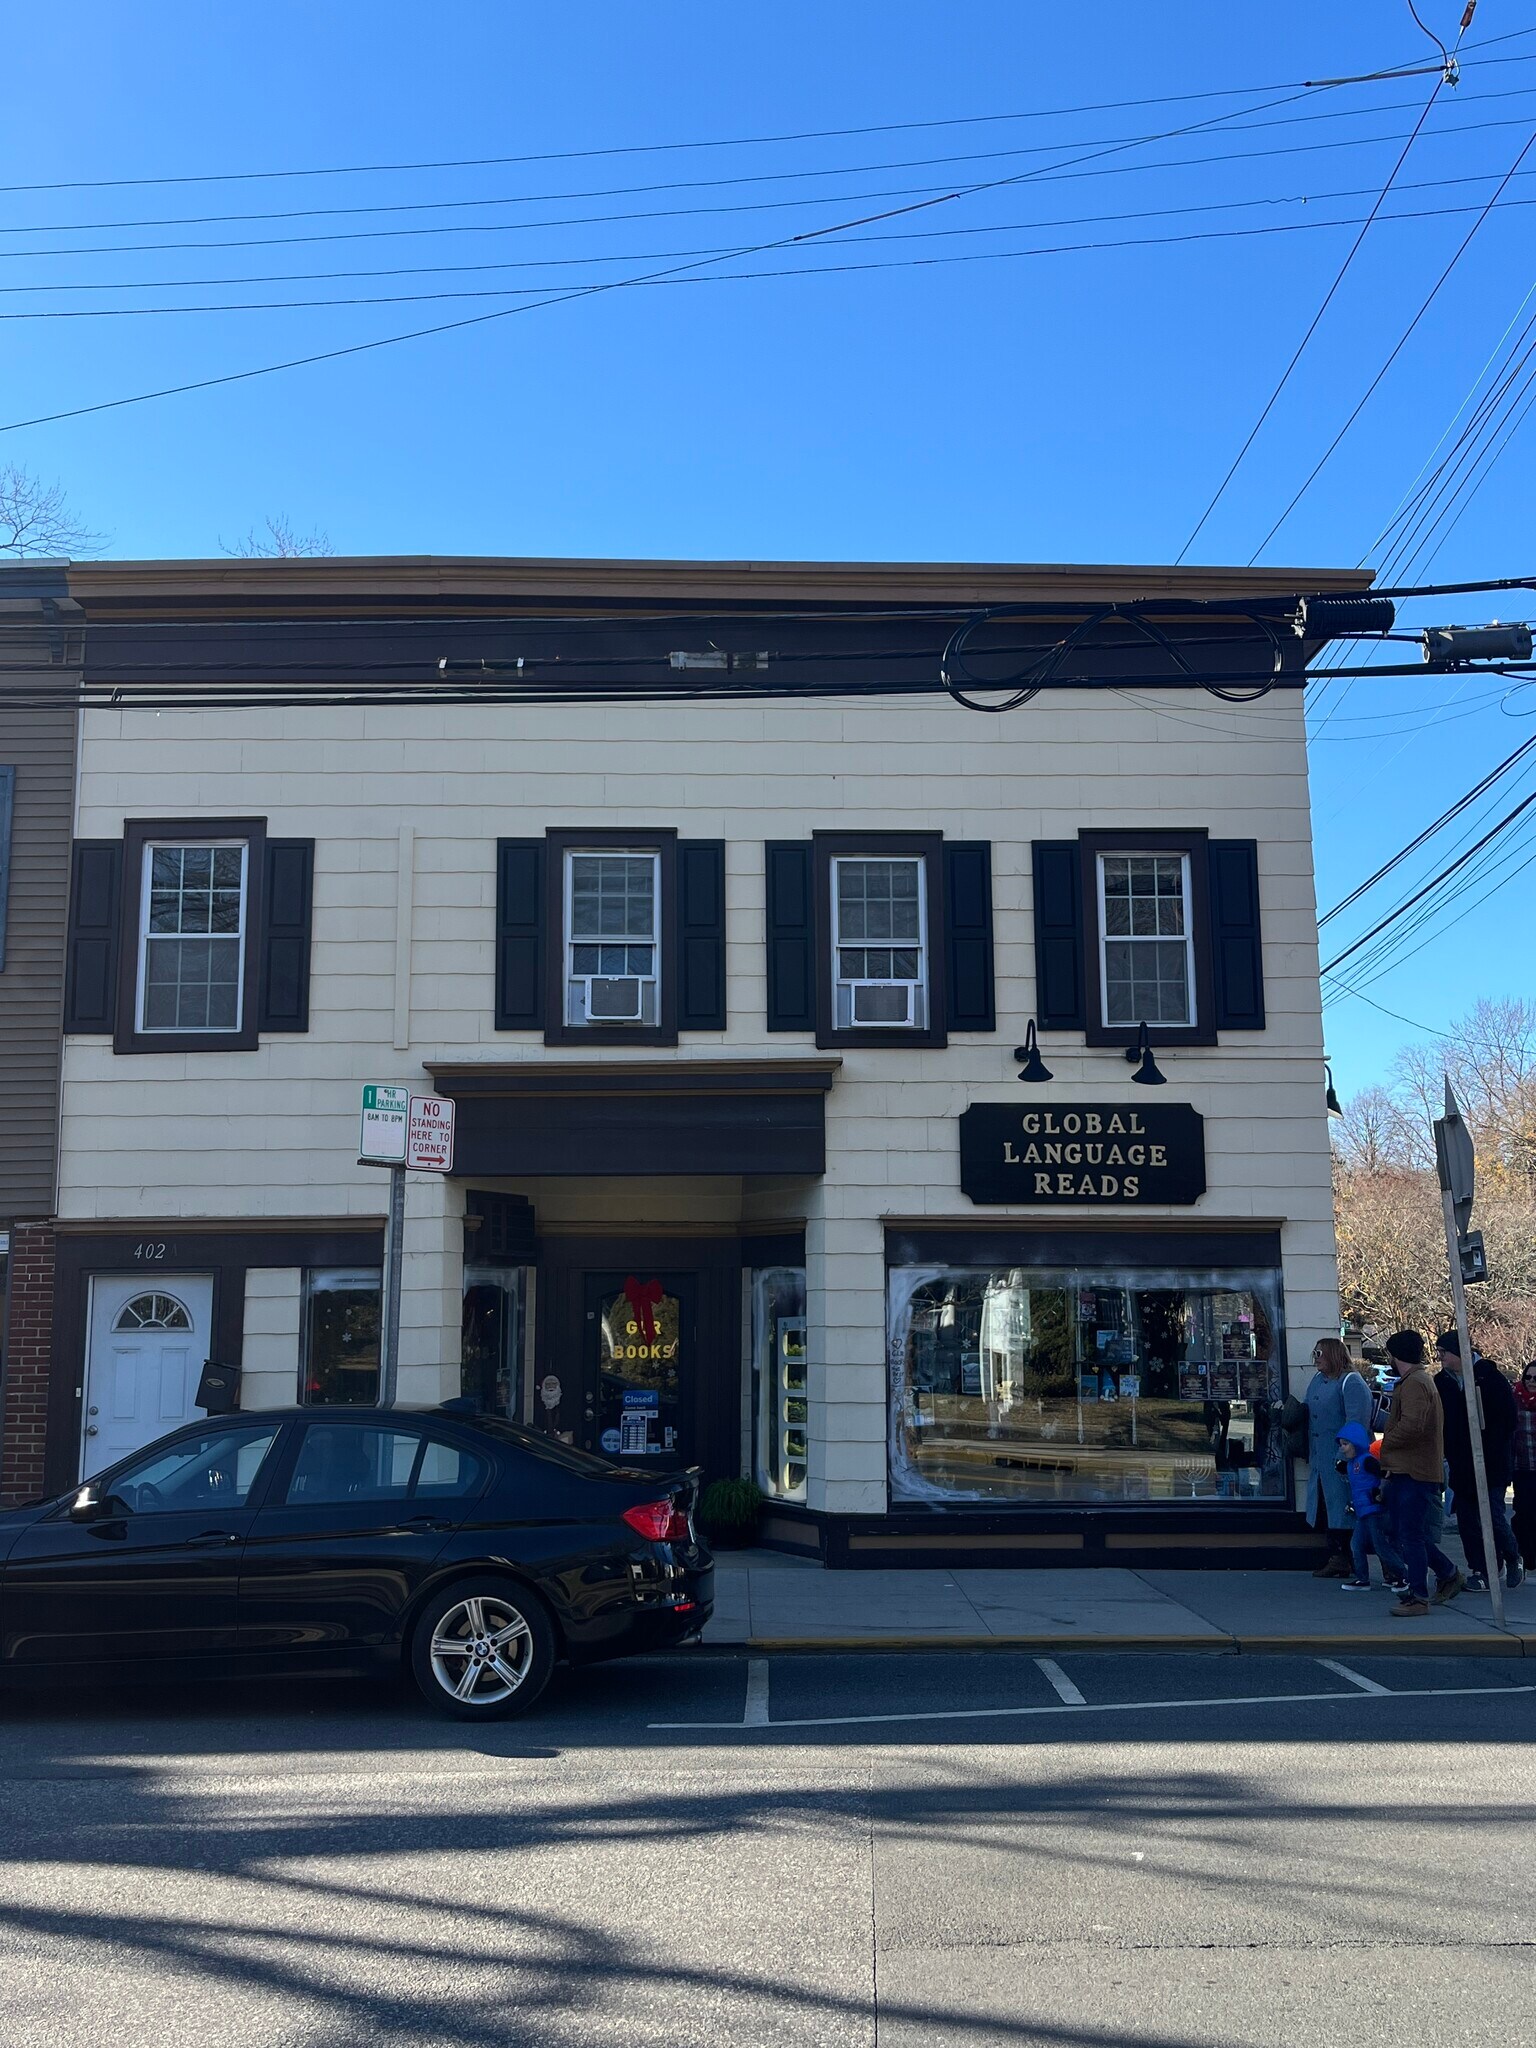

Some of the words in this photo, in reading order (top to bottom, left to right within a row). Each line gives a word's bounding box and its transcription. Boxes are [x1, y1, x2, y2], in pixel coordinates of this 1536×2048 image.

[368, 1090, 372, 1104] 1
[387, 1090, 396, 1098] HR
[377, 1098, 406, 1110] PARKING
[423, 1102, 440, 1117] NO
[367, 1112, 380, 1121] 8AM
[382, 1113, 389, 1122] TO
[391, 1114, 403, 1123] 8PM
[411, 1117, 451, 1130] STANDING
[1022, 1113, 1146, 1135] GLOBAL
[411, 1130, 432, 1141] HERE
[440, 1132, 450, 1142] TO
[412, 1142, 447, 1154] CORNER
[1003, 1142, 1168, 1167] LANGUAGE
[1034, 1172, 1140, 1198] READS
[134, 1243, 166, 1259] 402
[614, 1345, 674, 1359] BOOKS
[624, 1395, 653, 1403] Closed
